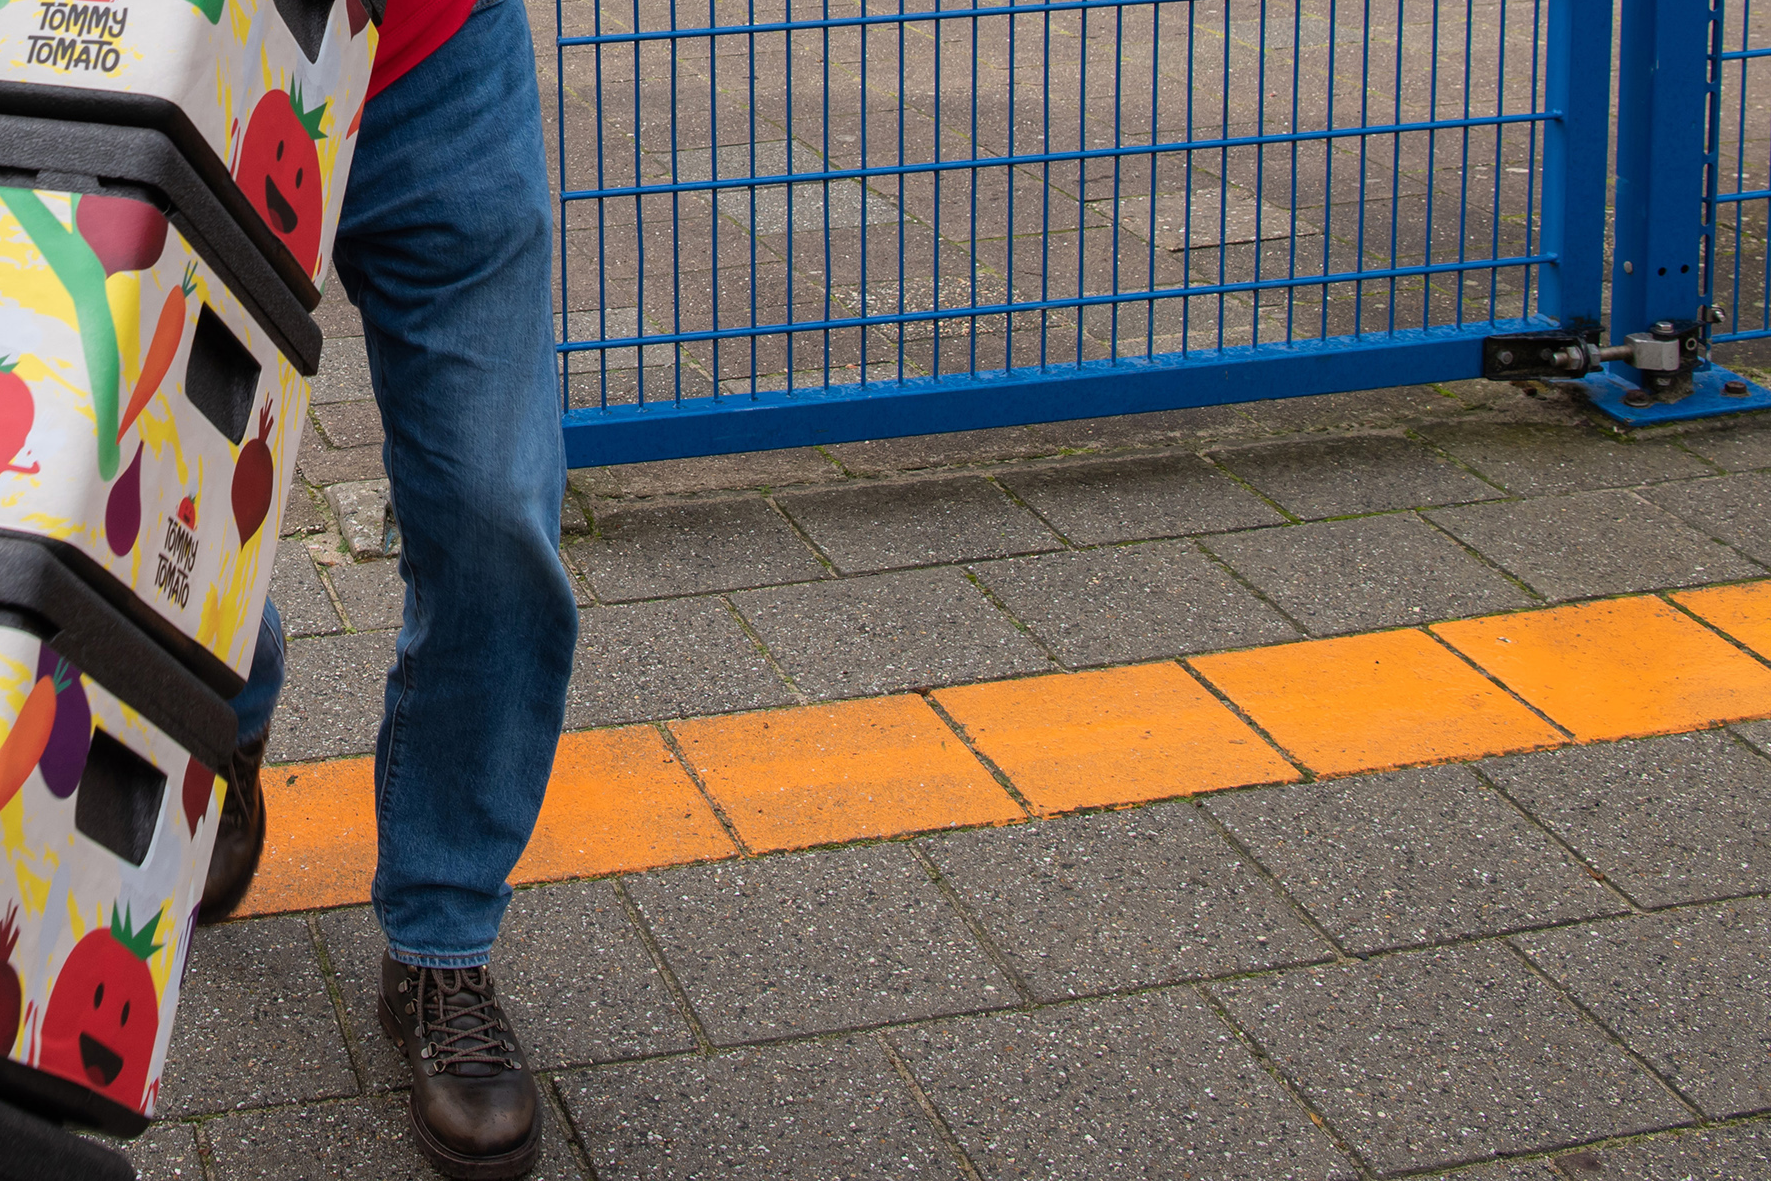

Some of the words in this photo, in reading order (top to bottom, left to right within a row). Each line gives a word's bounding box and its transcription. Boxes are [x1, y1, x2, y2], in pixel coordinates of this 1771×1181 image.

[39, 2, 128, 39] TOMMY
[26, 35, 120, 72] TOMATO
[164, 516, 199, 572] TOMMY
[154, 552, 189, 609] TOMATO
